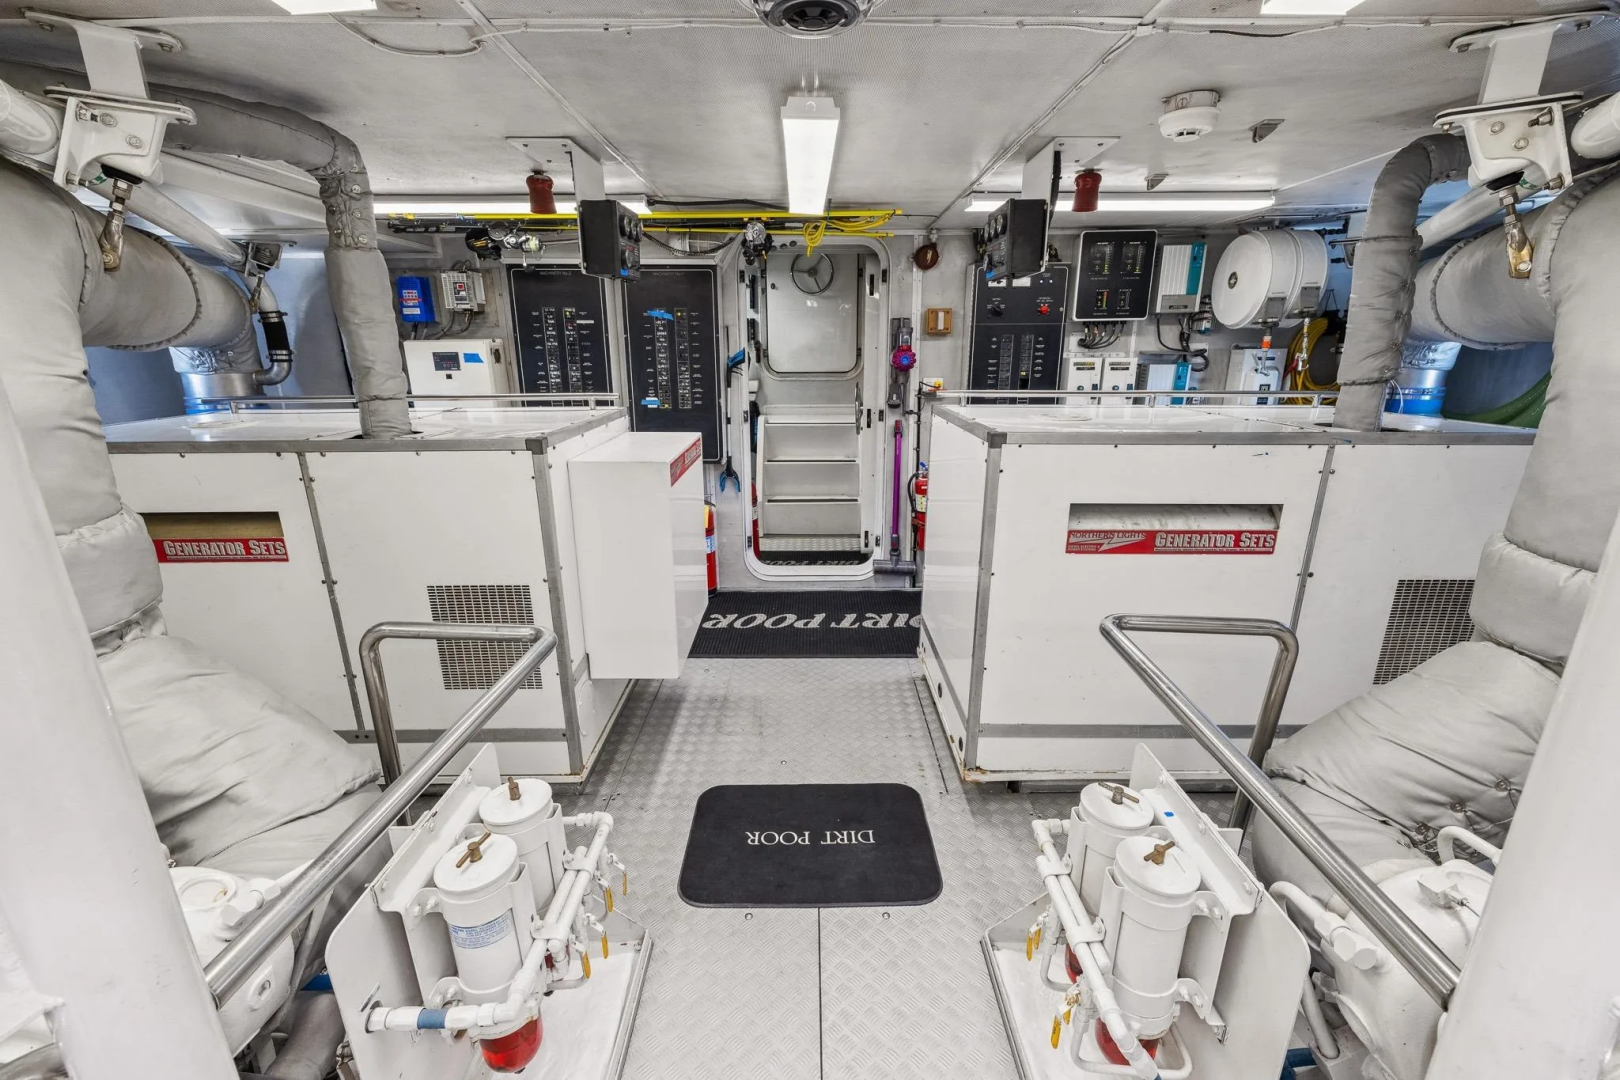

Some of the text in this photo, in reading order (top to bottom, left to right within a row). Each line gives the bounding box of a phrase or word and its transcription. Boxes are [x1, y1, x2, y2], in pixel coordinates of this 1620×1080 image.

[163, 540, 285, 555] GENERATOR SETS
[1154, 532, 1275, 547] GENERATOR SETS
[701, 612, 827, 629] POOR
[744, 829, 876, 846] DIRT POOR
